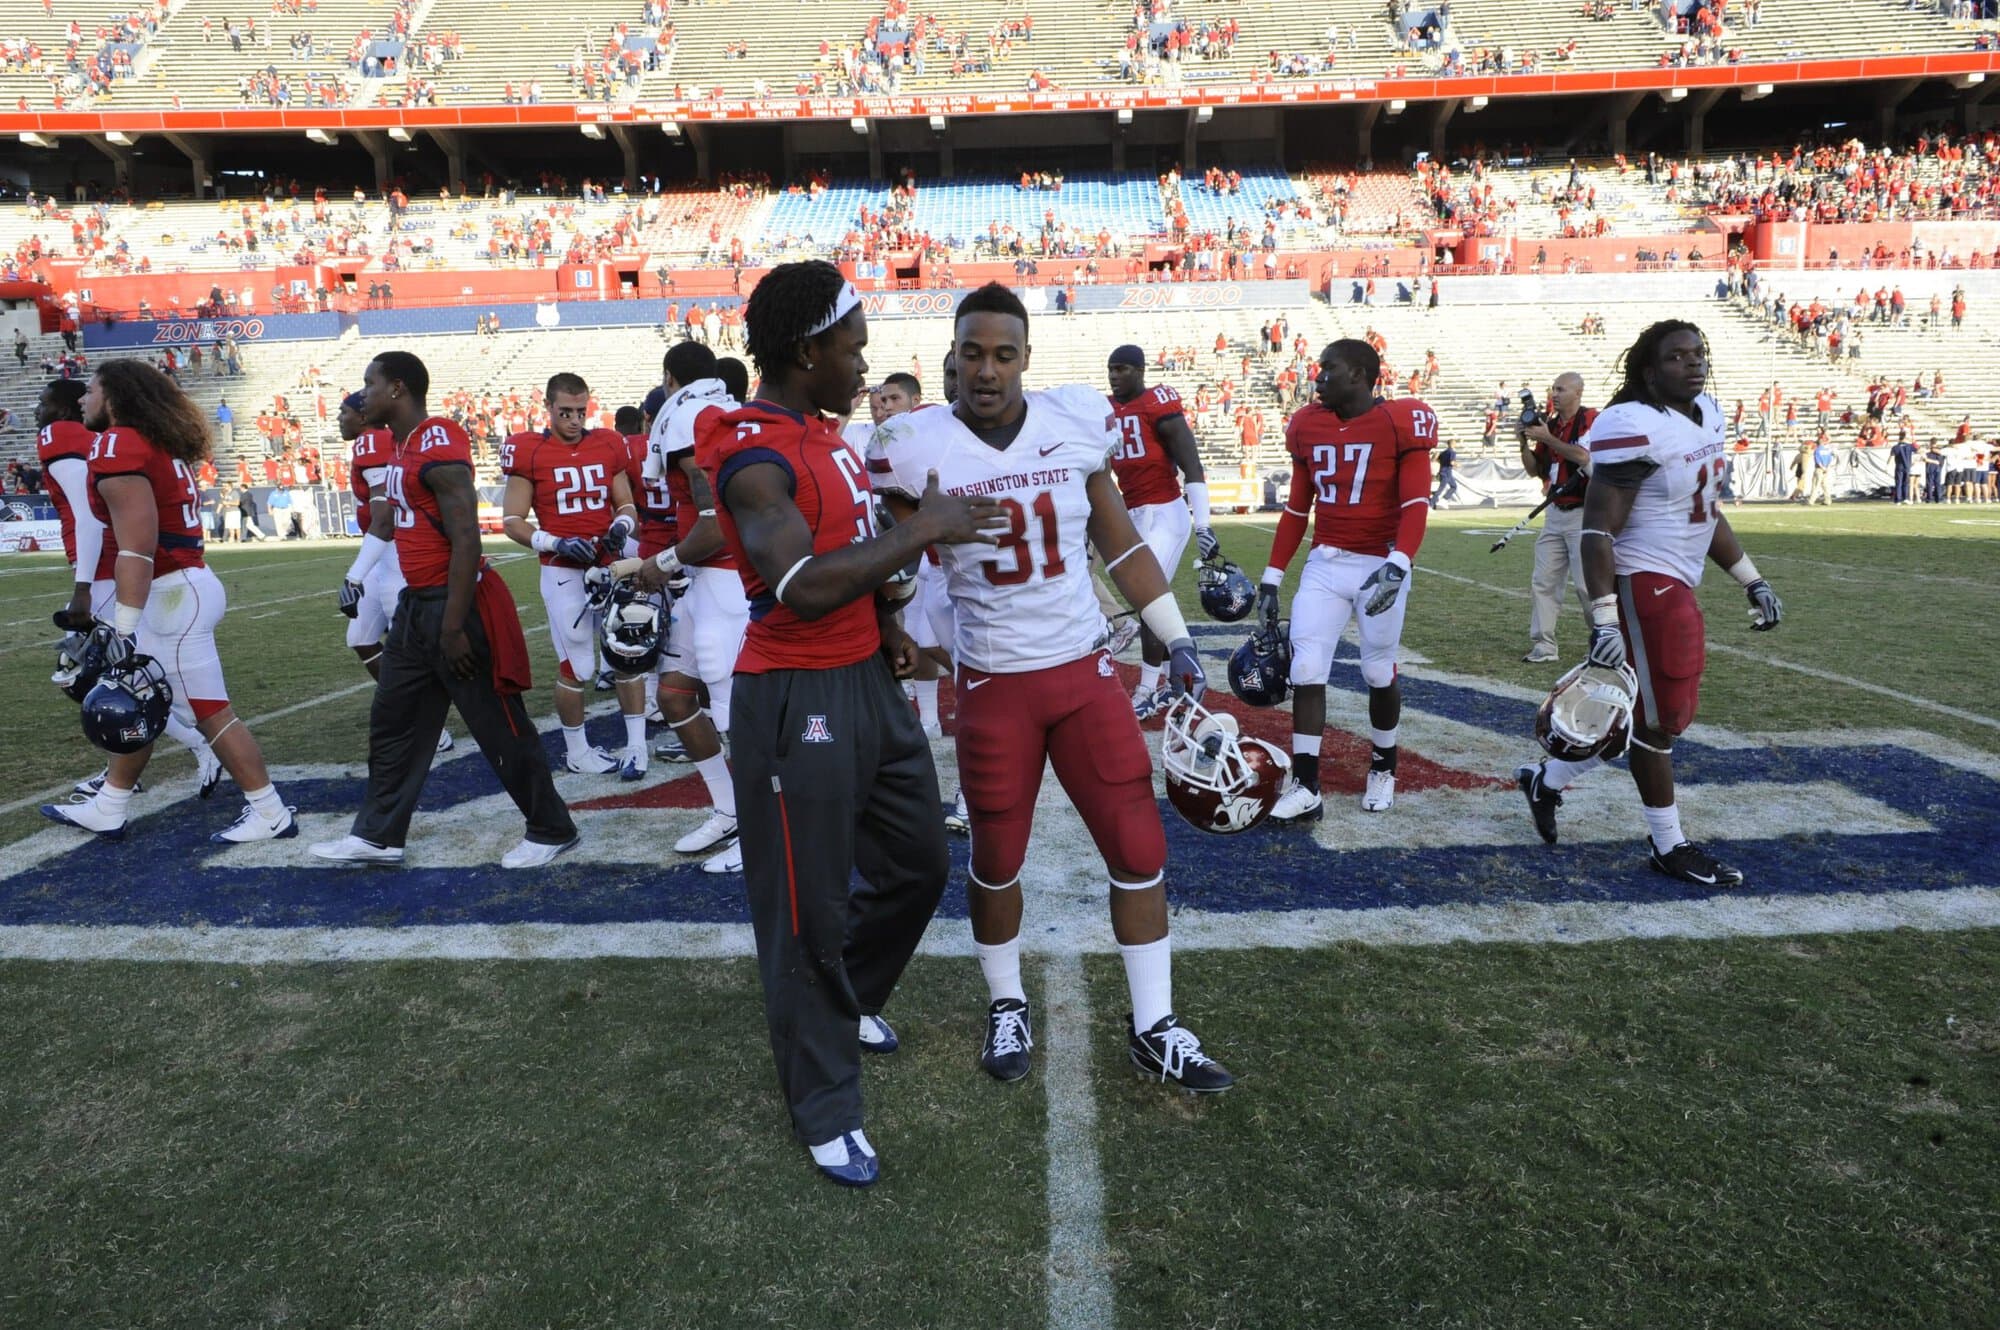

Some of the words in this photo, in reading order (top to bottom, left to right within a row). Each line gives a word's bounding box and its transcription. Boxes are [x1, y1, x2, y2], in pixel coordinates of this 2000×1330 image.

[860, 294, 887, 315] ON
[900, 292, 954, 313] ZOO
[1187, 284, 1243, 305] ZOO
[420, 425, 450, 453] 29
[1412, 409, 1437, 439] 27
[89, 431, 119, 461] 31
[354, 433, 377, 457] 21
[553, 463, 608, 515] 25
[947, 473, 1029, 498] WASHINGTON
[1032, 468, 1069, 487] STATE
[1312, 443, 1373, 505] 27
[979, 490, 1067, 586] 31
[802, 714, 832, 742] A
